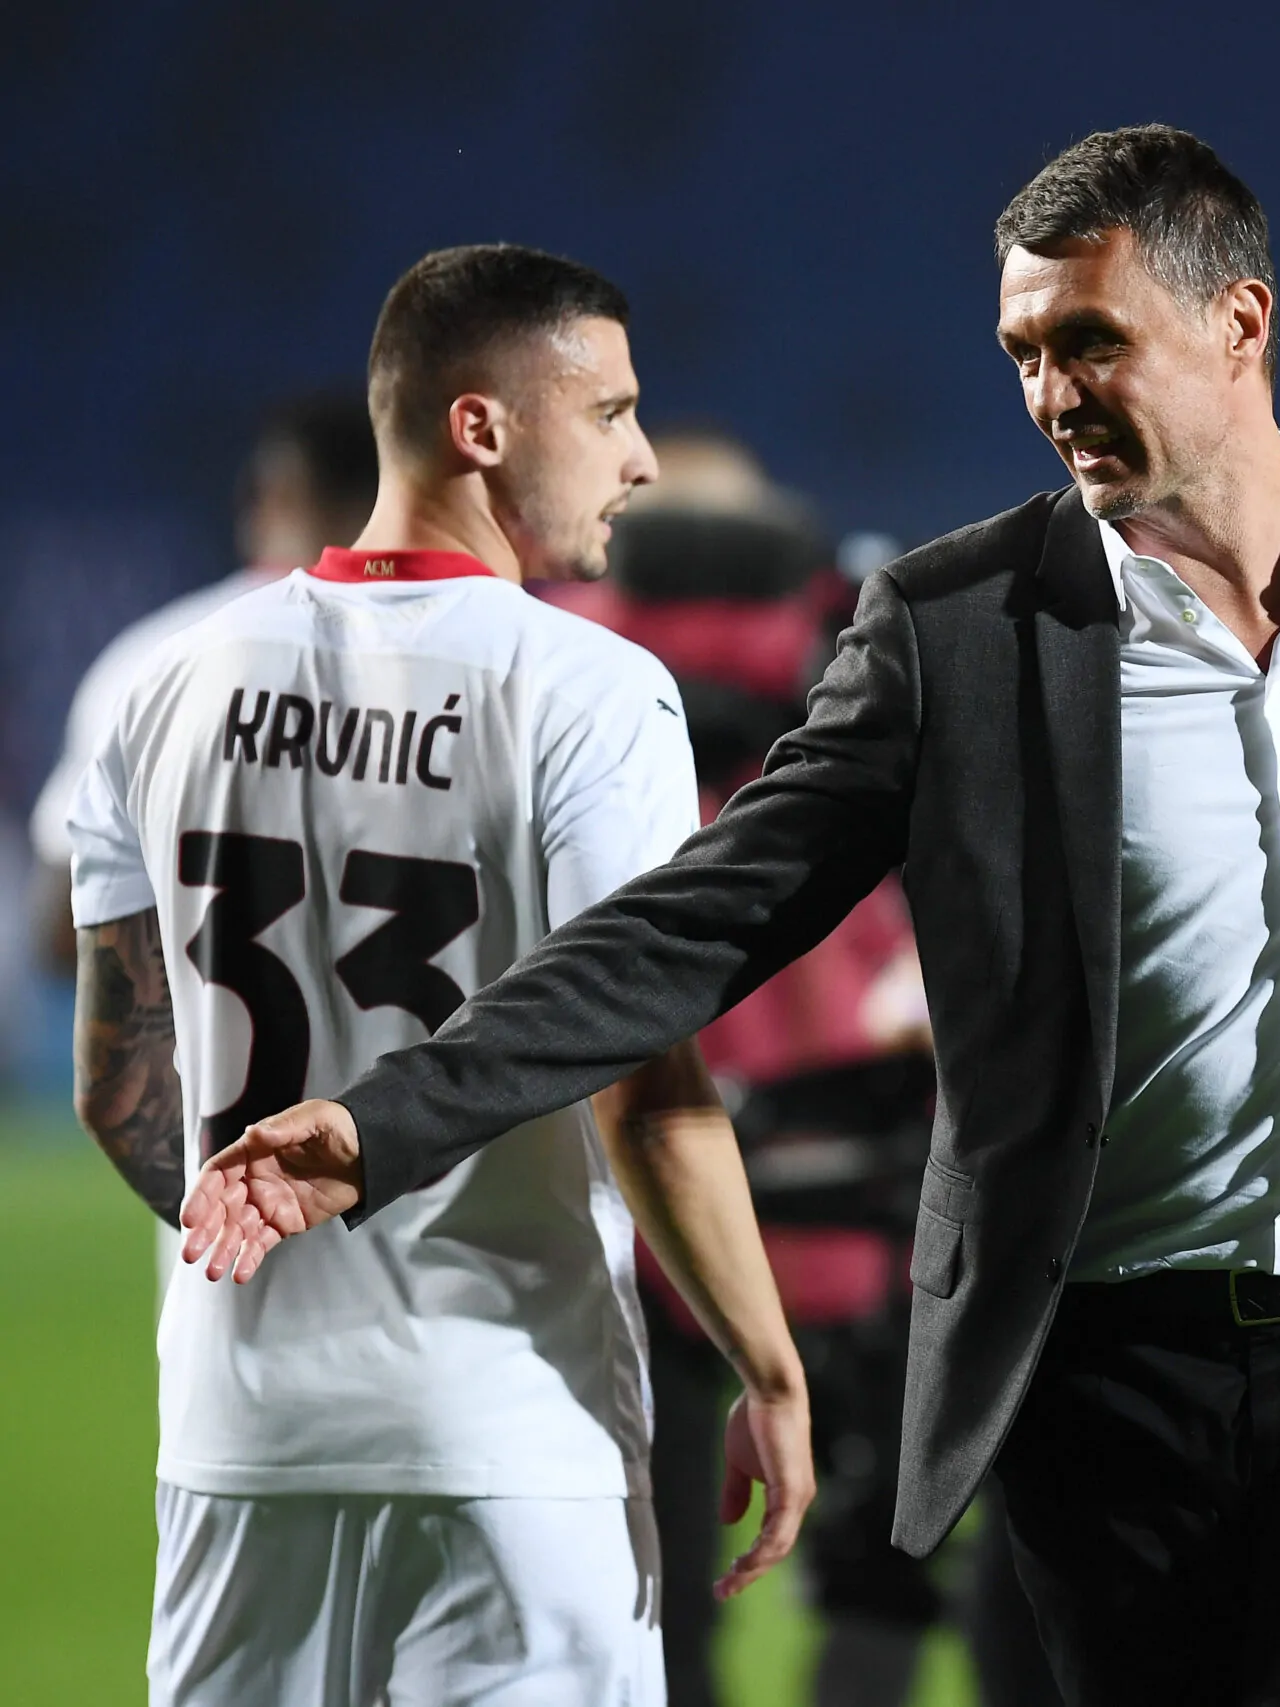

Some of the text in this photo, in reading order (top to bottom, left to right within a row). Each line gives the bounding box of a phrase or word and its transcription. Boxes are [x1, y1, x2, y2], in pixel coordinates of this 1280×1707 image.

[363, 559, 396, 578] ACM
[222, 687, 463, 792] KRUNIĆ
[178, 830, 480, 1158] 33
